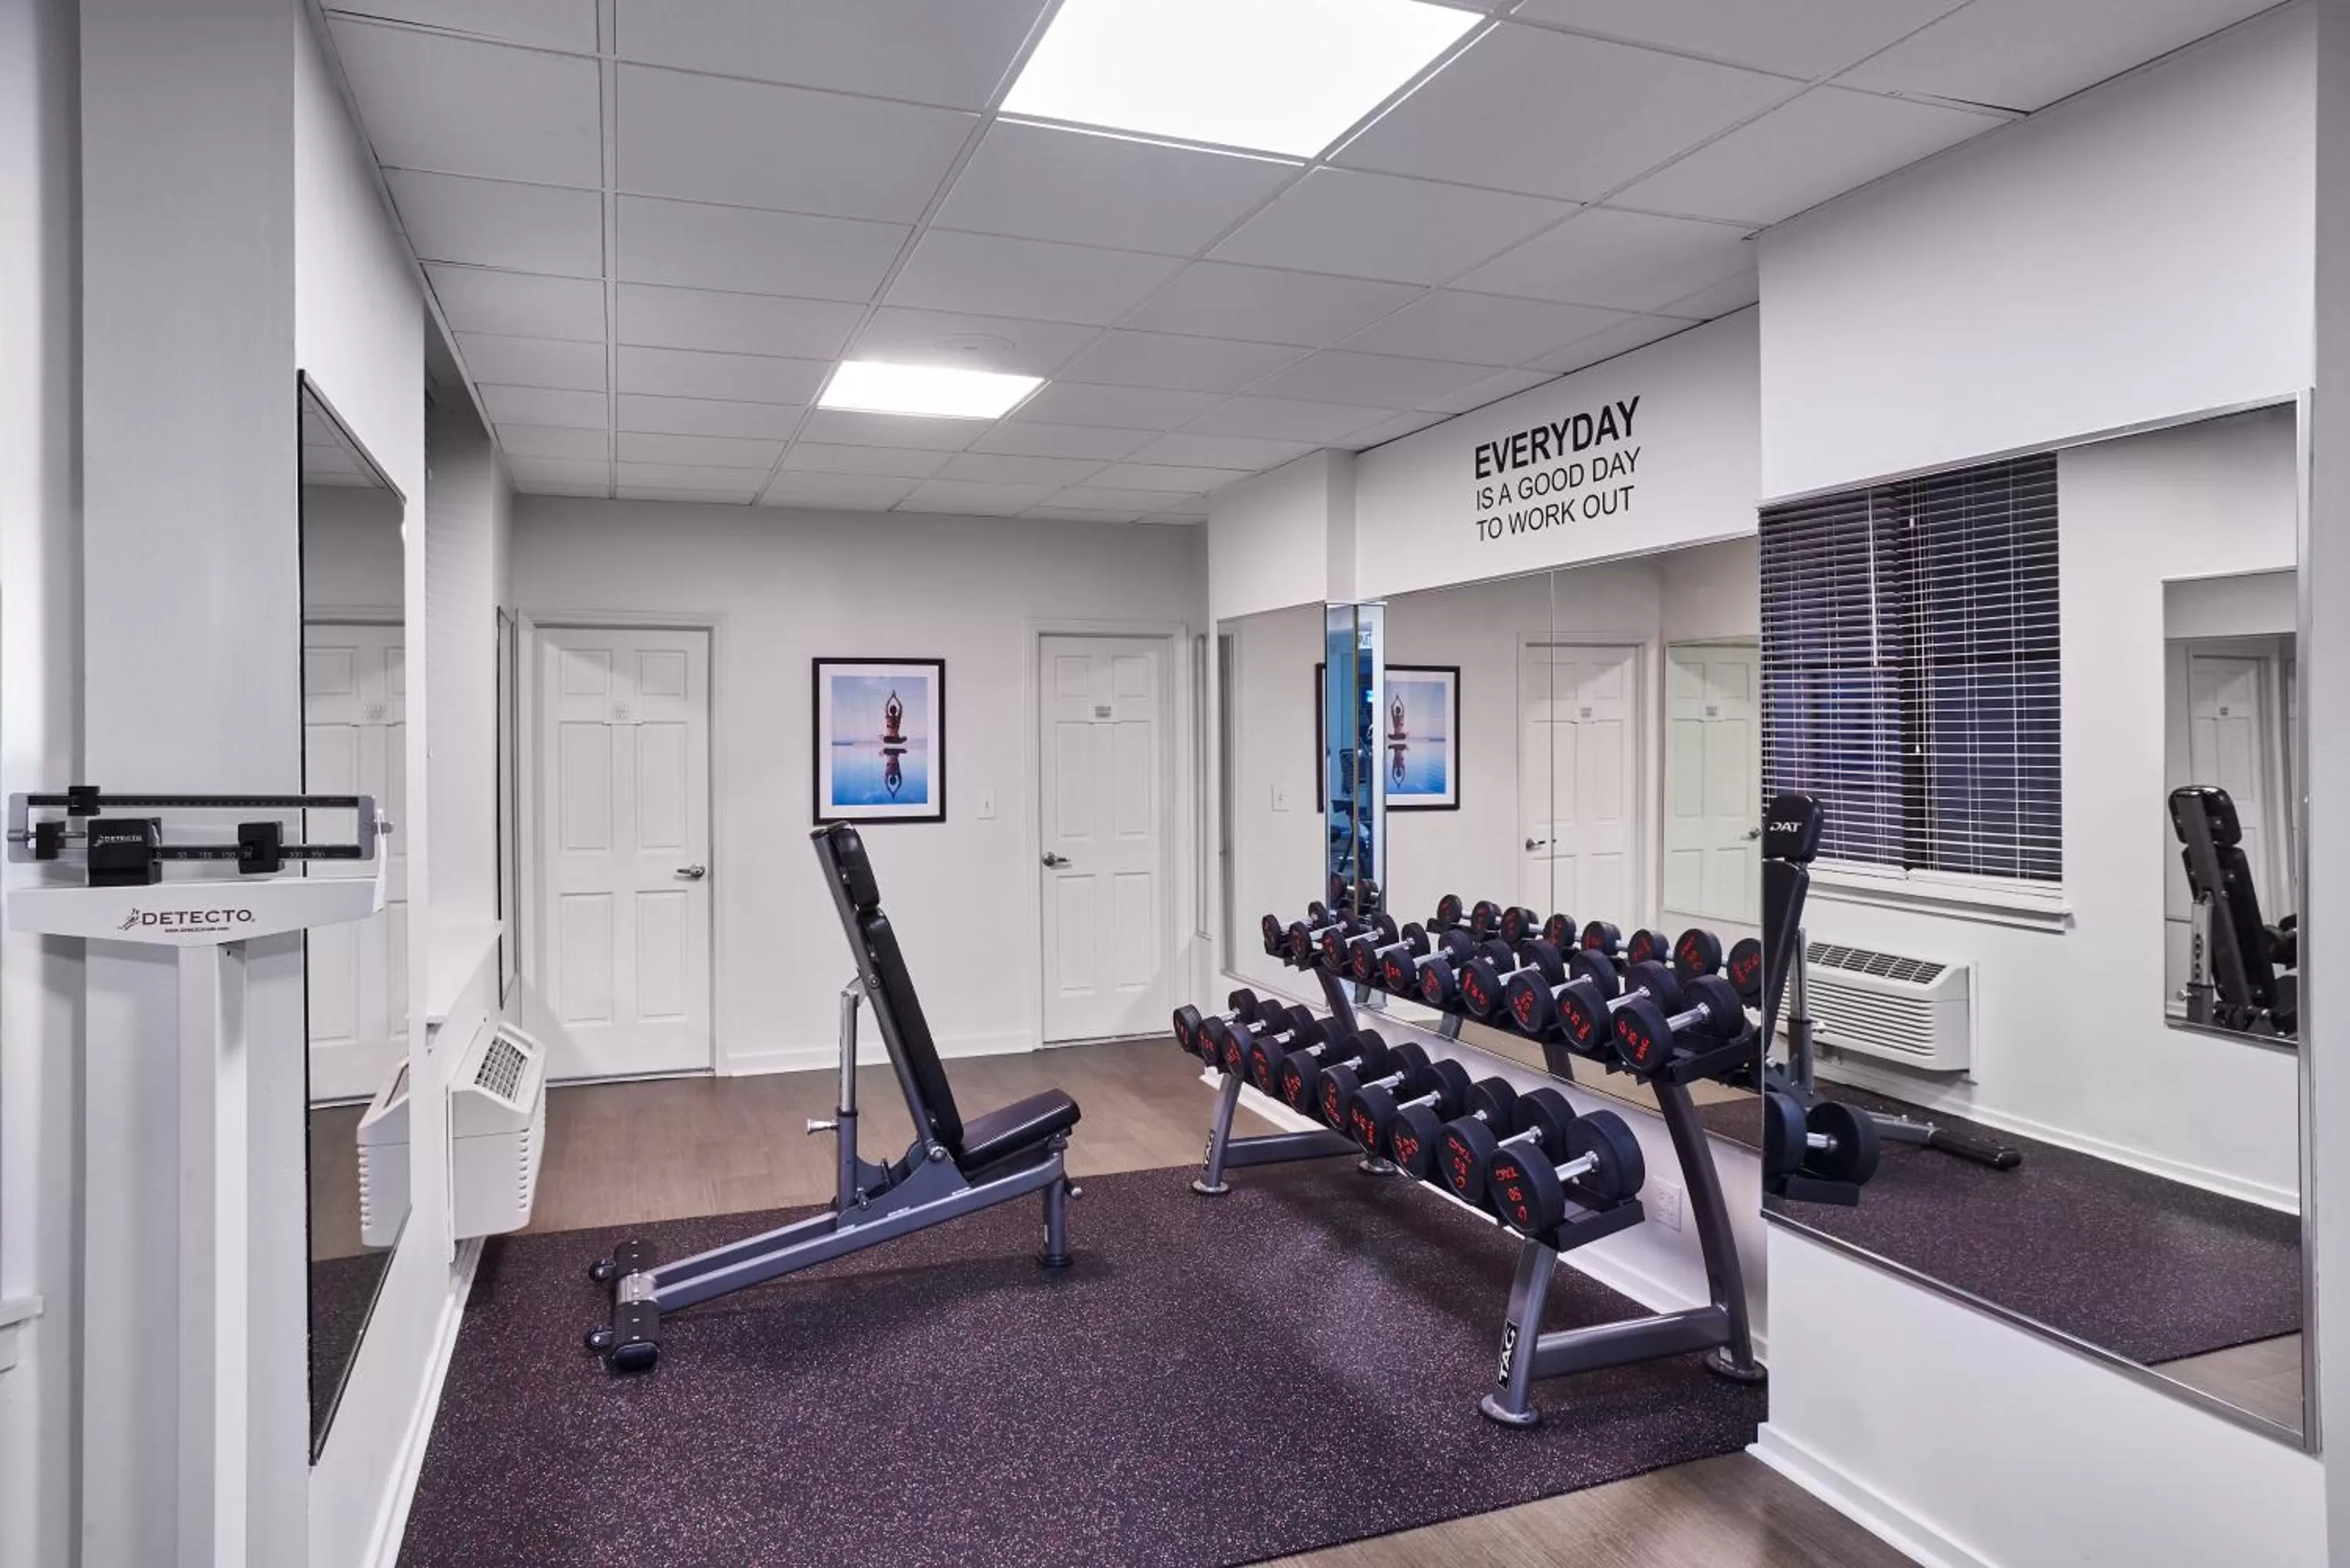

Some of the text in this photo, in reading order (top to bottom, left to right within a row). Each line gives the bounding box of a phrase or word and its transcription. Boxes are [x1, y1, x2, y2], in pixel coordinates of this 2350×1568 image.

[1475, 395, 1640, 479] EVERYDAY
[1477, 446, 1641, 511] IS A GOOD DAY
[1476, 485, 1635, 541] TO WORK OUT
[142, 909, 252, 925] DETECTO
[1499, 1327, 1516, 1382] TAG
